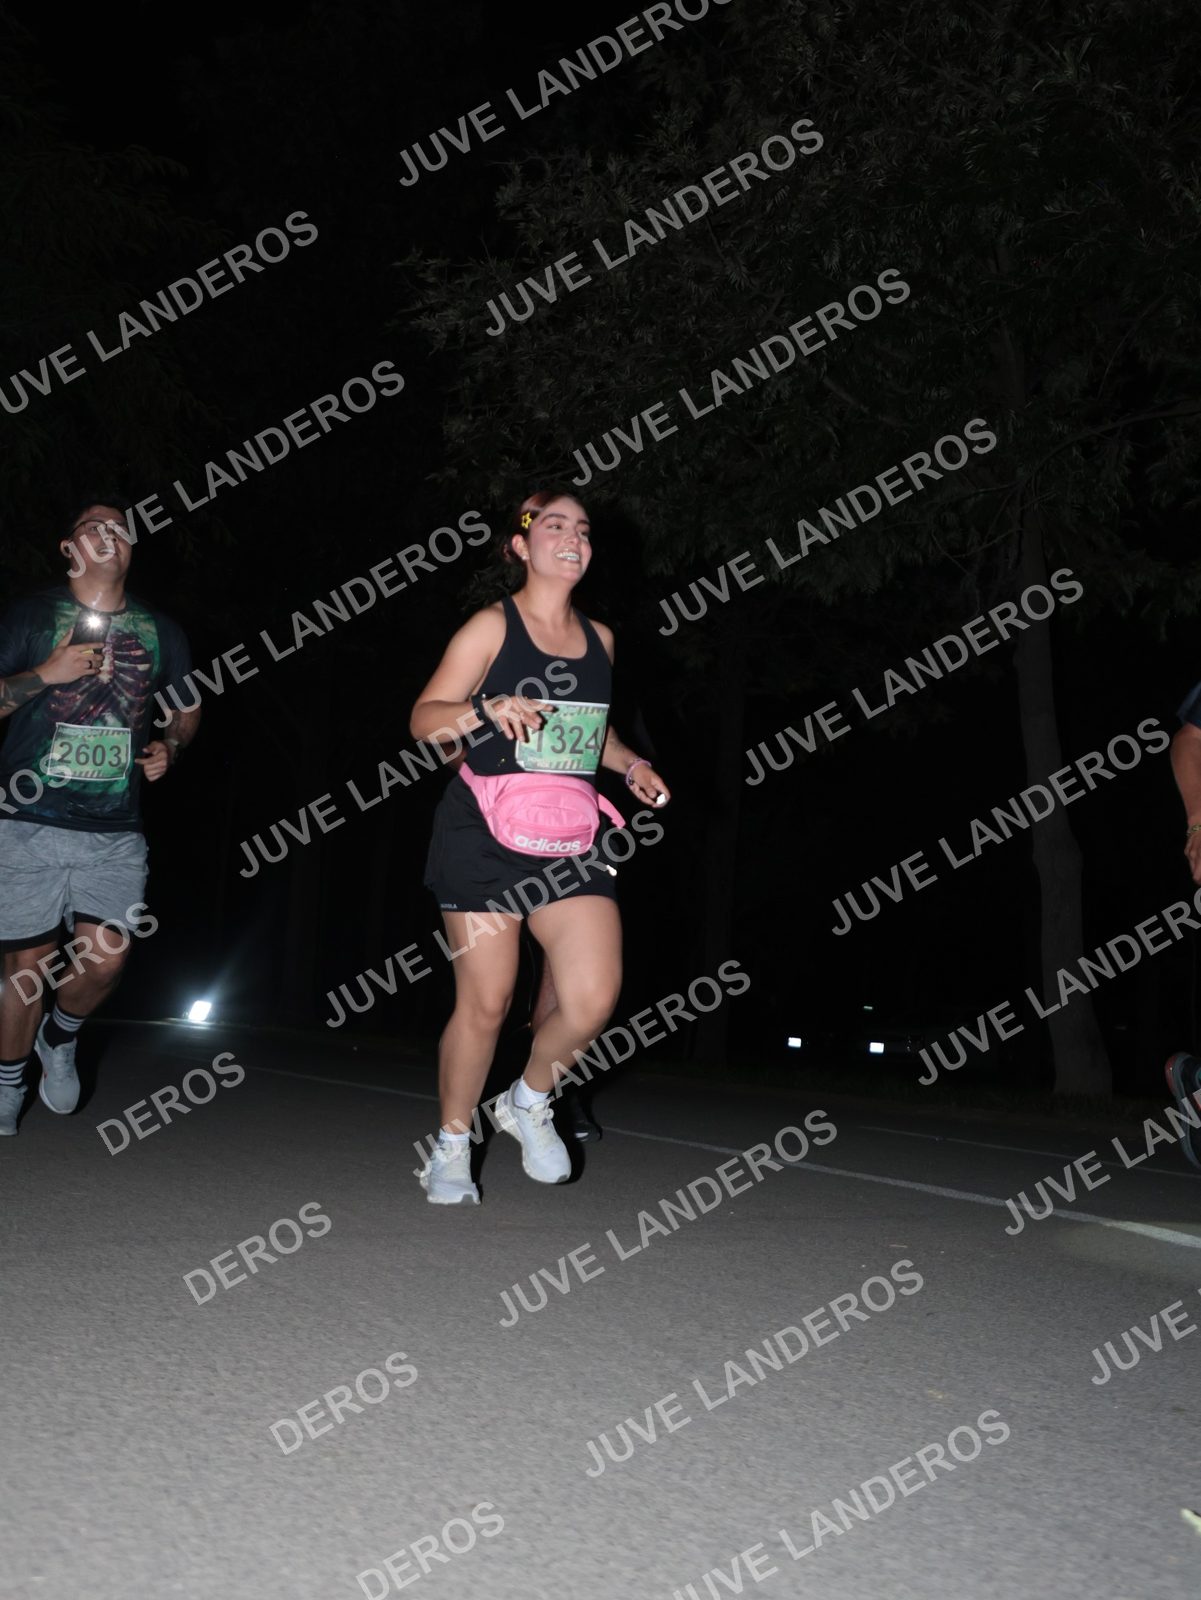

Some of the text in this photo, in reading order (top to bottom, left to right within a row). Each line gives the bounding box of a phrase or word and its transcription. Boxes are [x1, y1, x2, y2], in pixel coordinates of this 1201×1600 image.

[531, 724, 601, 756] 1324
[56, 741, 122, 767] 2603
[514, 834, 581, 852] adidas
